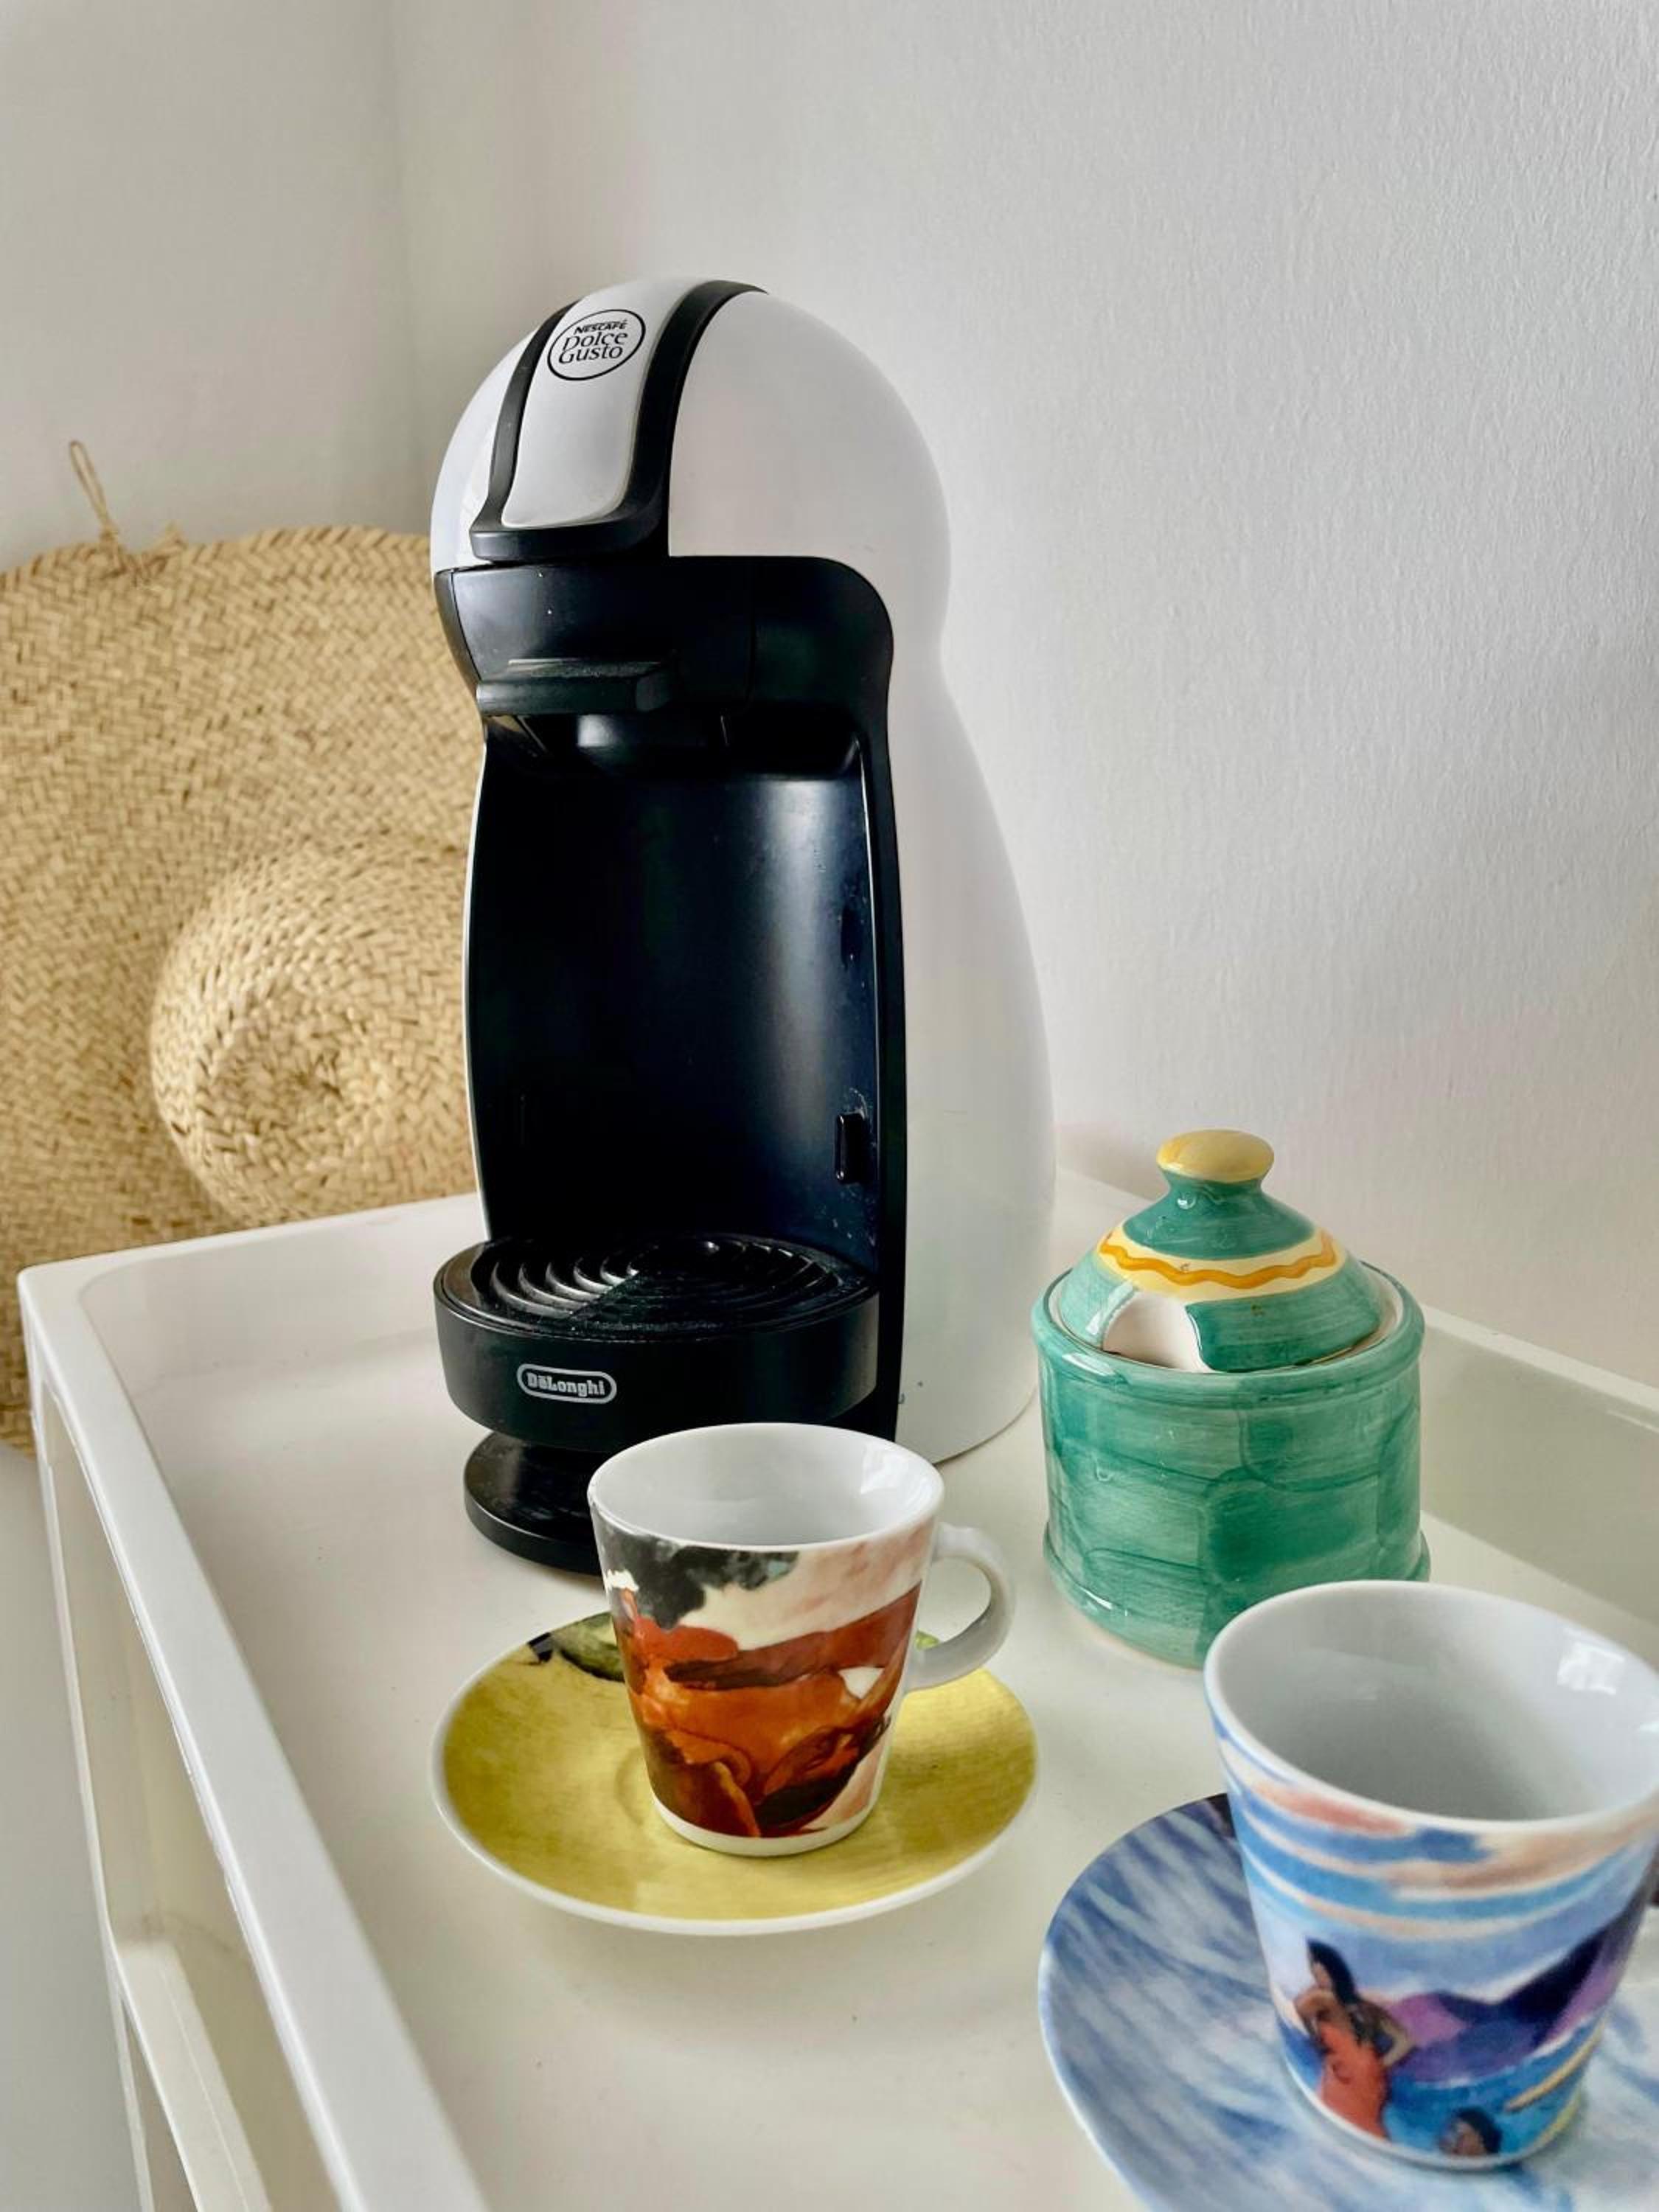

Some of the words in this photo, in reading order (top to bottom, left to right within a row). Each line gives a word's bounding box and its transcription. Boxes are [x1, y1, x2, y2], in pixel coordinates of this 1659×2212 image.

[574, 320, 627, 335] NESCAFÉ
[563, 332, 628, 351] Dolce
[558, 344, 623, 364] Gusto
